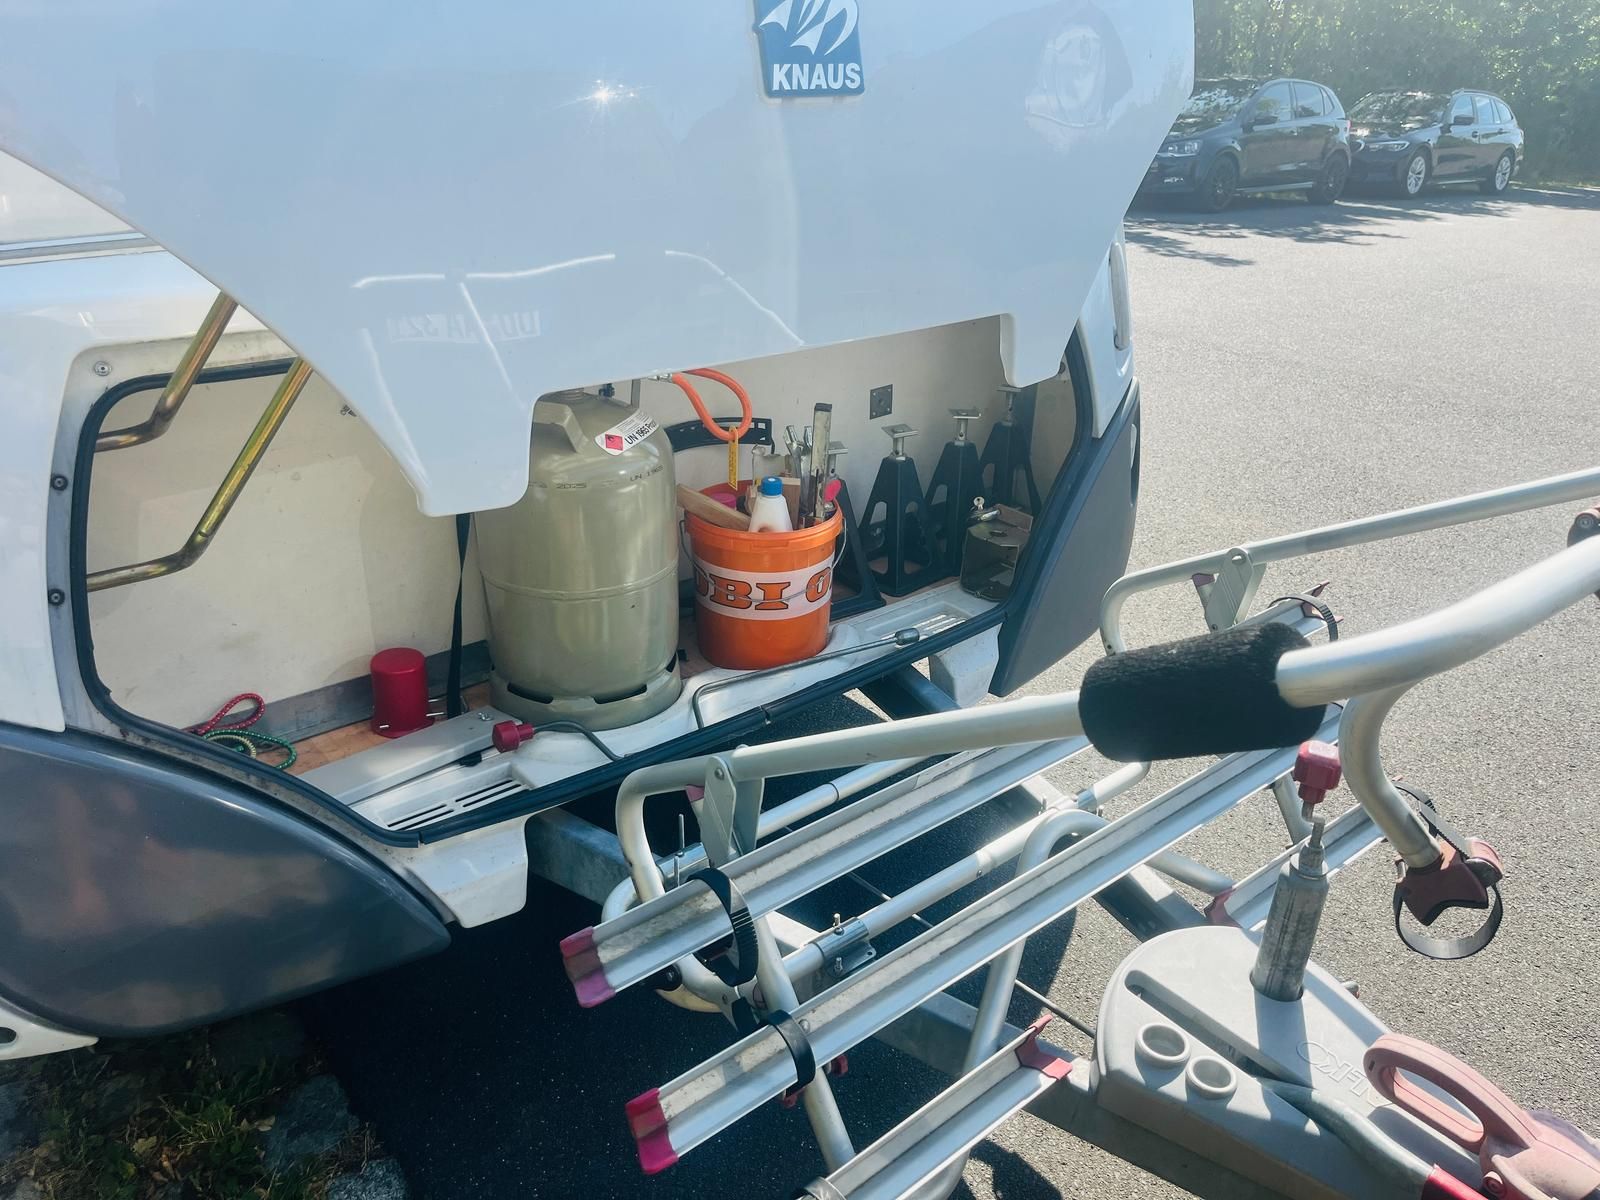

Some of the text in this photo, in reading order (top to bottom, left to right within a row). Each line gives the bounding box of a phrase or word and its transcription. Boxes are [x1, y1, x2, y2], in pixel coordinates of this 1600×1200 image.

[772, 62, 861, 91] KNAUS
[625, 433, 639, 445] UN
[630, 473, 642, 481] UN
